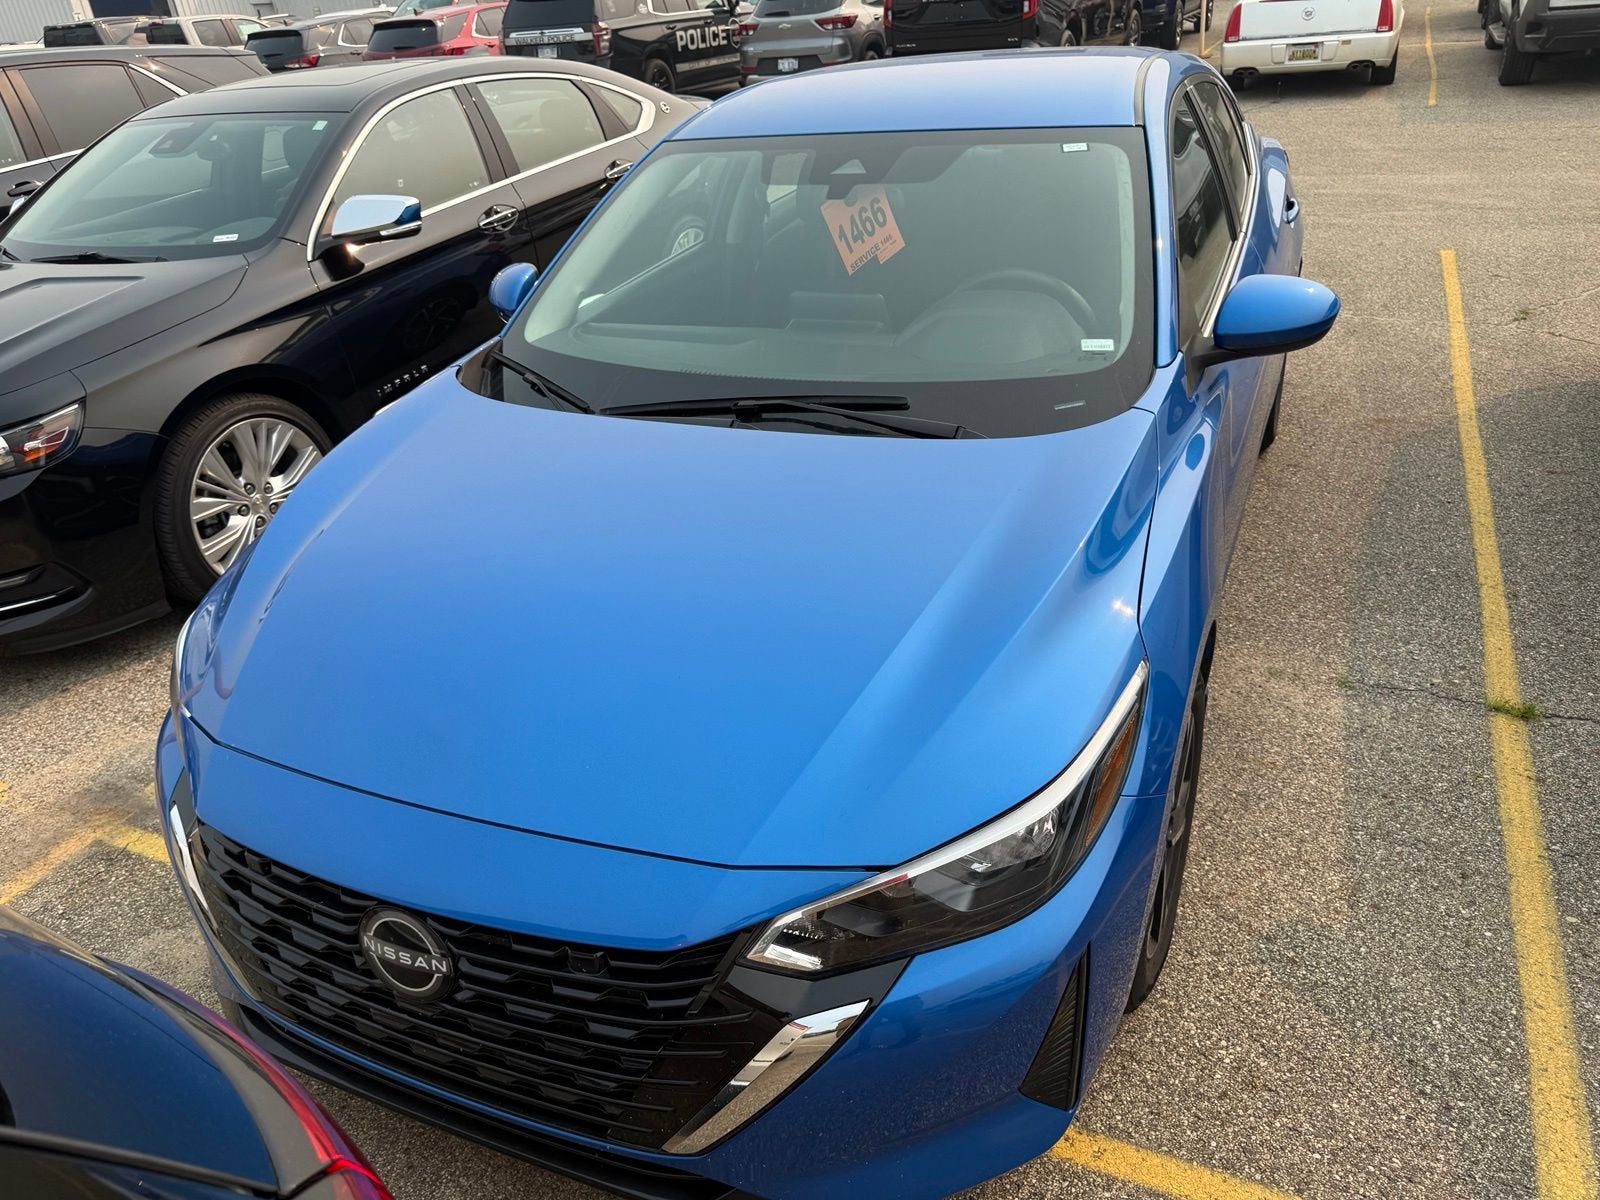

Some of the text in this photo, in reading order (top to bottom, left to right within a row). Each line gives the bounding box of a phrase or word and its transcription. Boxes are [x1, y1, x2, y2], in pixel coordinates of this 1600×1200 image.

[547, 33, 575, 43] POLICE
[675, 25, 728, 52] POLICE
[838, 197, 888, 254] 1466
[850, 242, 881, 272] SERVICE
[363, 935, 447, 973] NISSAN
